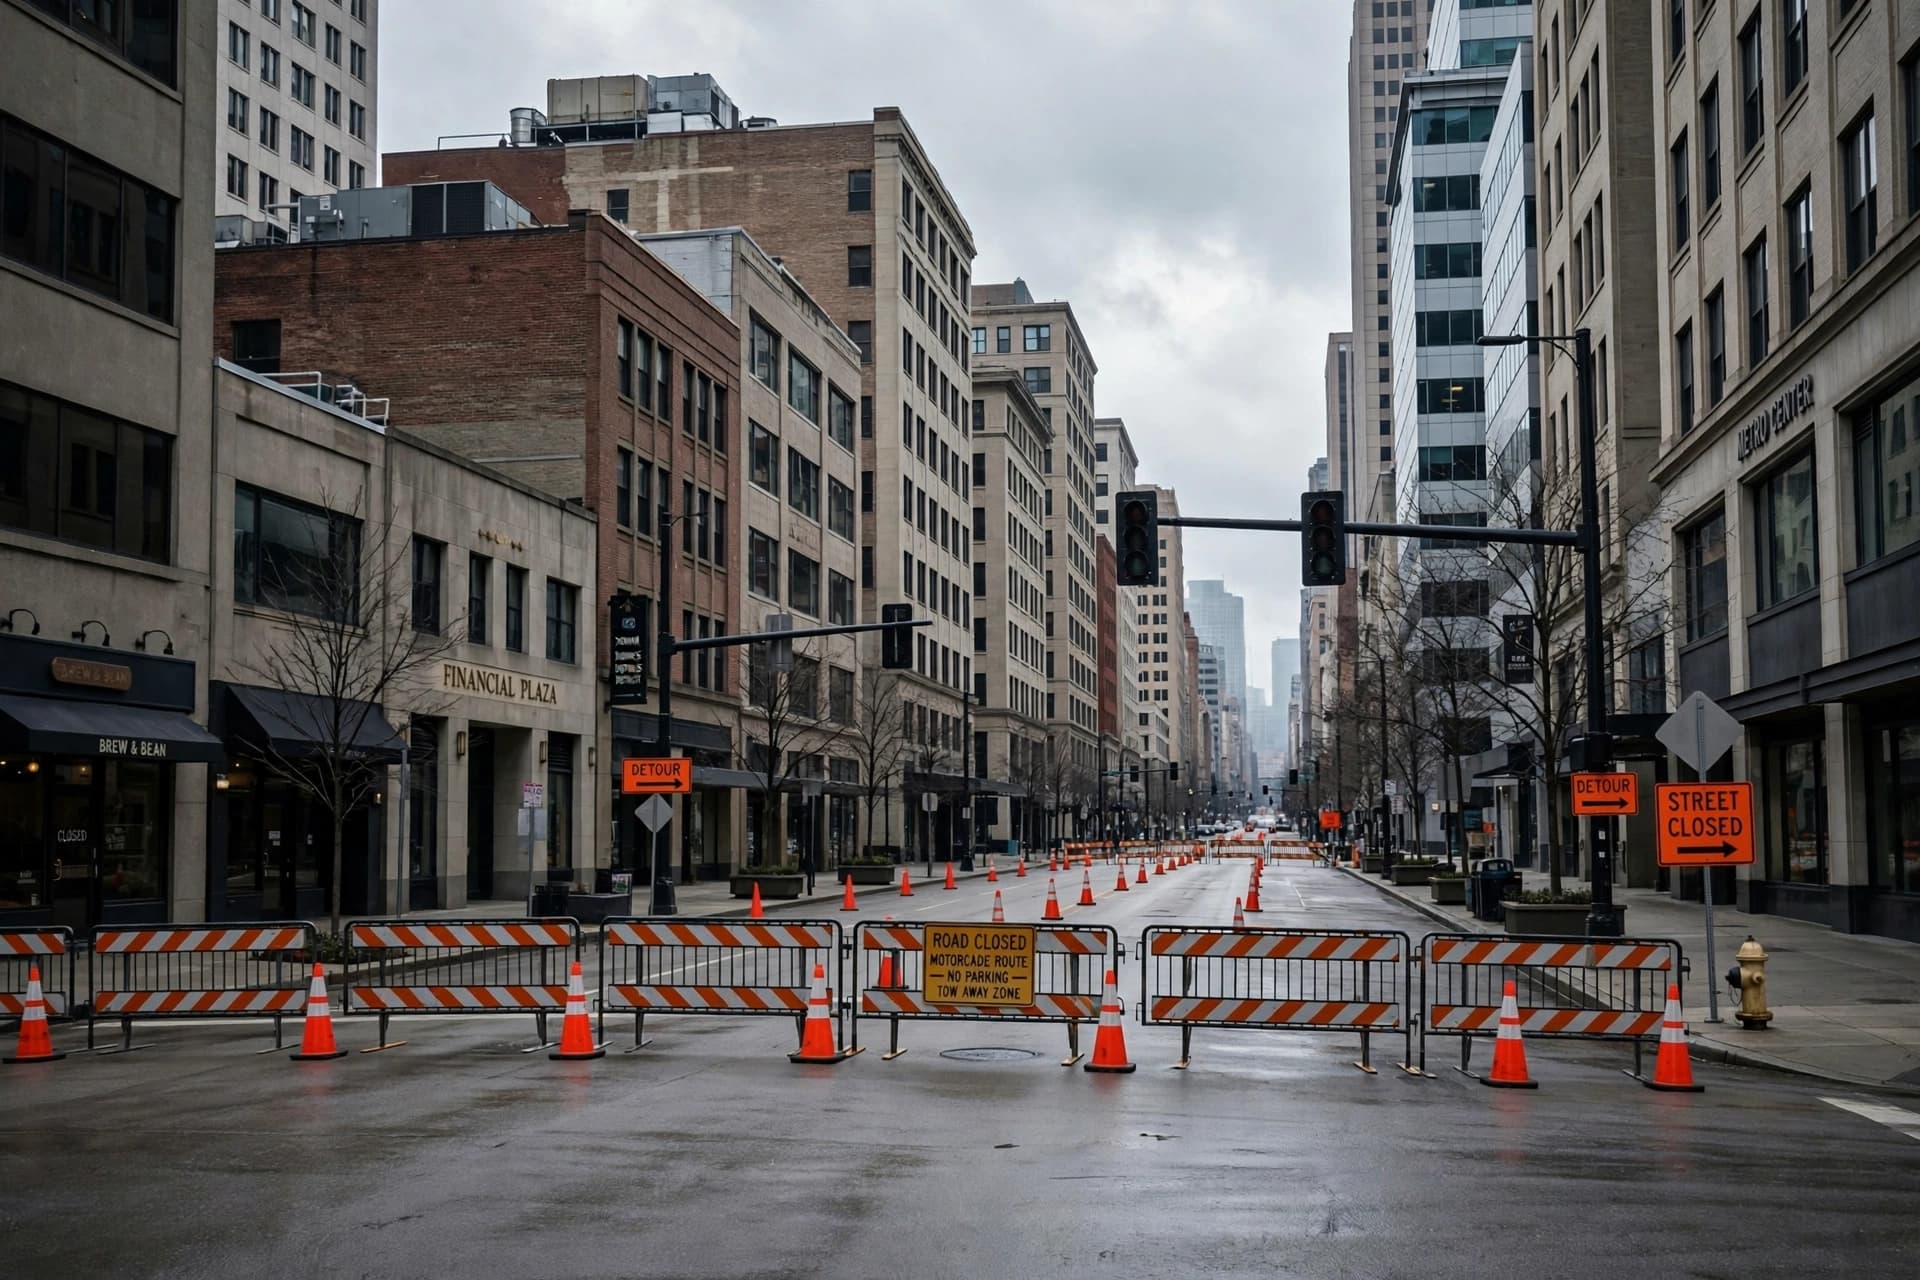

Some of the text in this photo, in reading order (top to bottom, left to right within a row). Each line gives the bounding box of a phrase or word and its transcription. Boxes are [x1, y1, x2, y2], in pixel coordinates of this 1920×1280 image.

[1771, 375, 1815, 434] CENTER
[443, 664, 557, 704] FINANCIAL PLAZA
[99, 738, 167, 757] BREW & BEAN
[632, 763, 681, 777] DETOUR
[1576, 779, 1631, 793] DETOUR
[1668, 791, 1739, 811] STREET
[1668, 817, 1743, 837] CLOSED
[57, 829, 87, 842] CLOSED
[933, 932, 1027, 950] ROAD CLOSED
[930, 954, 1028, 968] MOTORCADE ROUTE
[947, 971, 1009, 983] NO PARKING
[938, 985, 1021, 999] TOW AWAY ZONE
